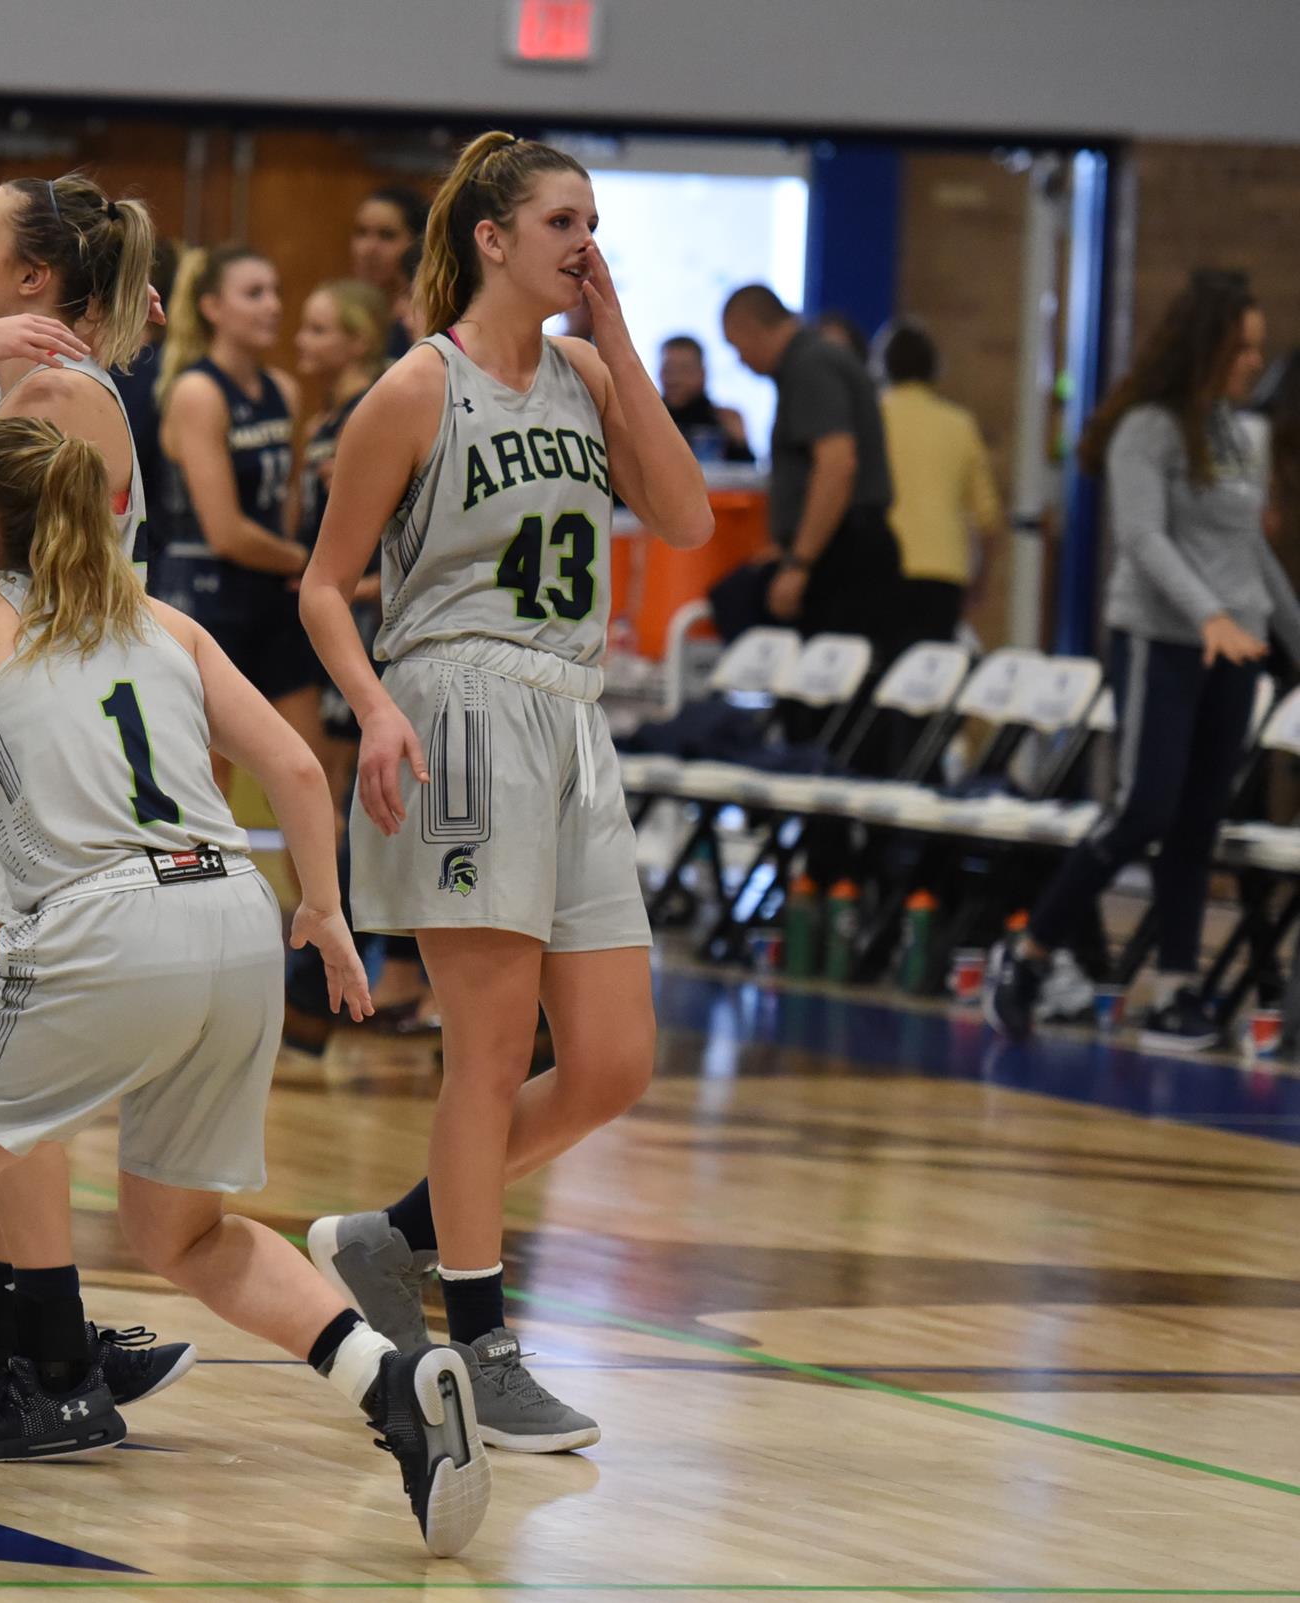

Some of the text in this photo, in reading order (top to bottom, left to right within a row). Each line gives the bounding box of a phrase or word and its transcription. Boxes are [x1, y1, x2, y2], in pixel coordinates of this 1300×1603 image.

[462, 427, 611, 512] ARGOS
[495, 512, 596, 624] 43
[98, 679, 184, 828] 1
